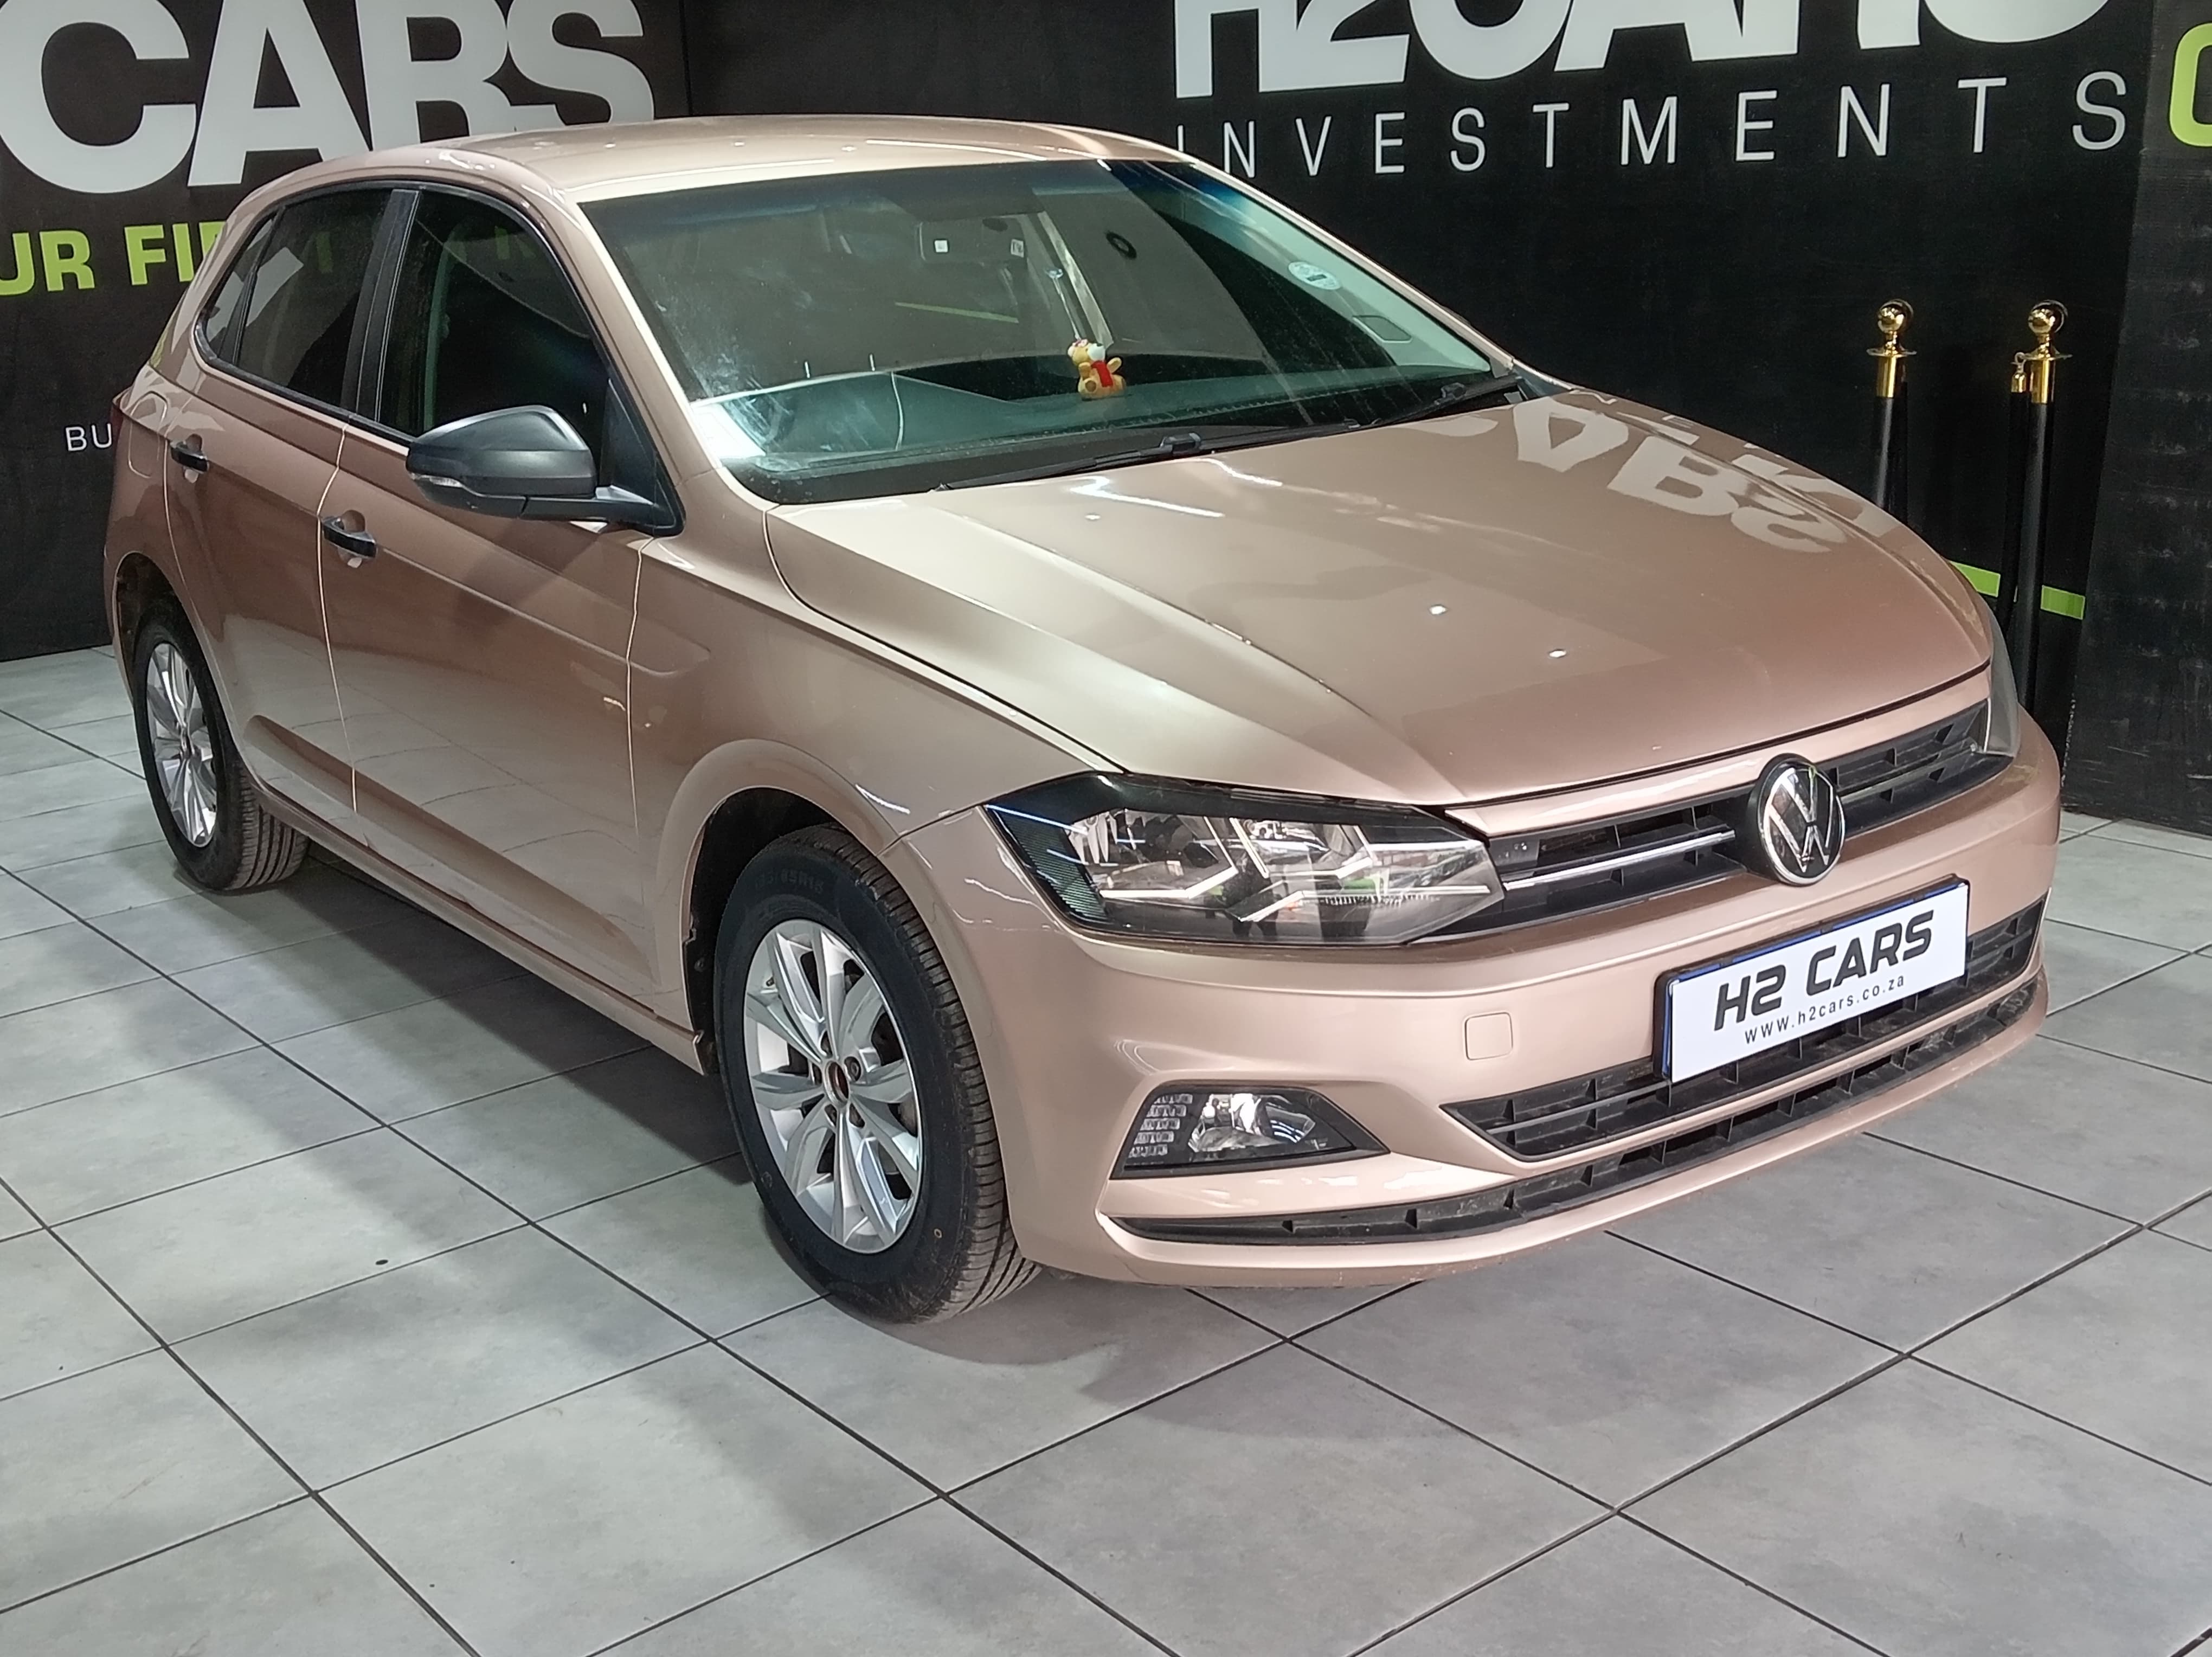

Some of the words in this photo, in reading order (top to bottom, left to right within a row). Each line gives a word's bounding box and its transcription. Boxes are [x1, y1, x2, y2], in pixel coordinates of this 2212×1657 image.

[0, 0, 654, 193] CARS
[124, 221, 226, 285] FI
[65, 423, 112, 451] BU
[1714, 965, 1786, 1031] H2
[1806, 910, 1934, 996] CARS
[1745, 975, 1904, 1044] www.h2cars.co.za
